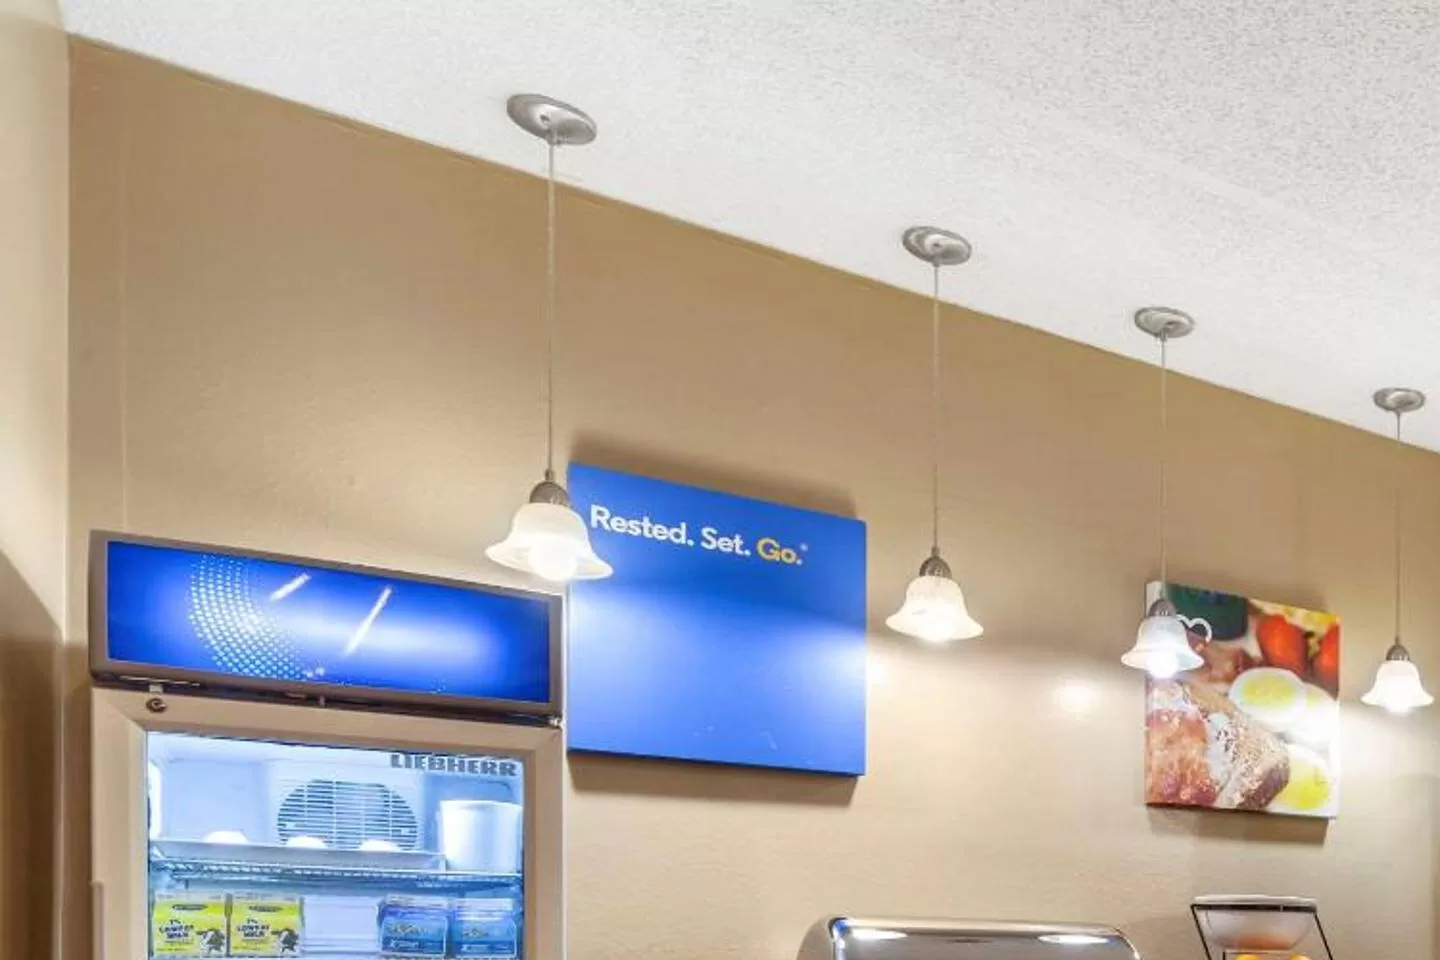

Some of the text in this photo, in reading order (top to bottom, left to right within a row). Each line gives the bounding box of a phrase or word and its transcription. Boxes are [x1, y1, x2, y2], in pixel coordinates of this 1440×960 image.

[590, 504, 695, 546] Rested.
[700, 526, 751, 557] Set.
[390, 754, 517, 776] LIEBHERR
